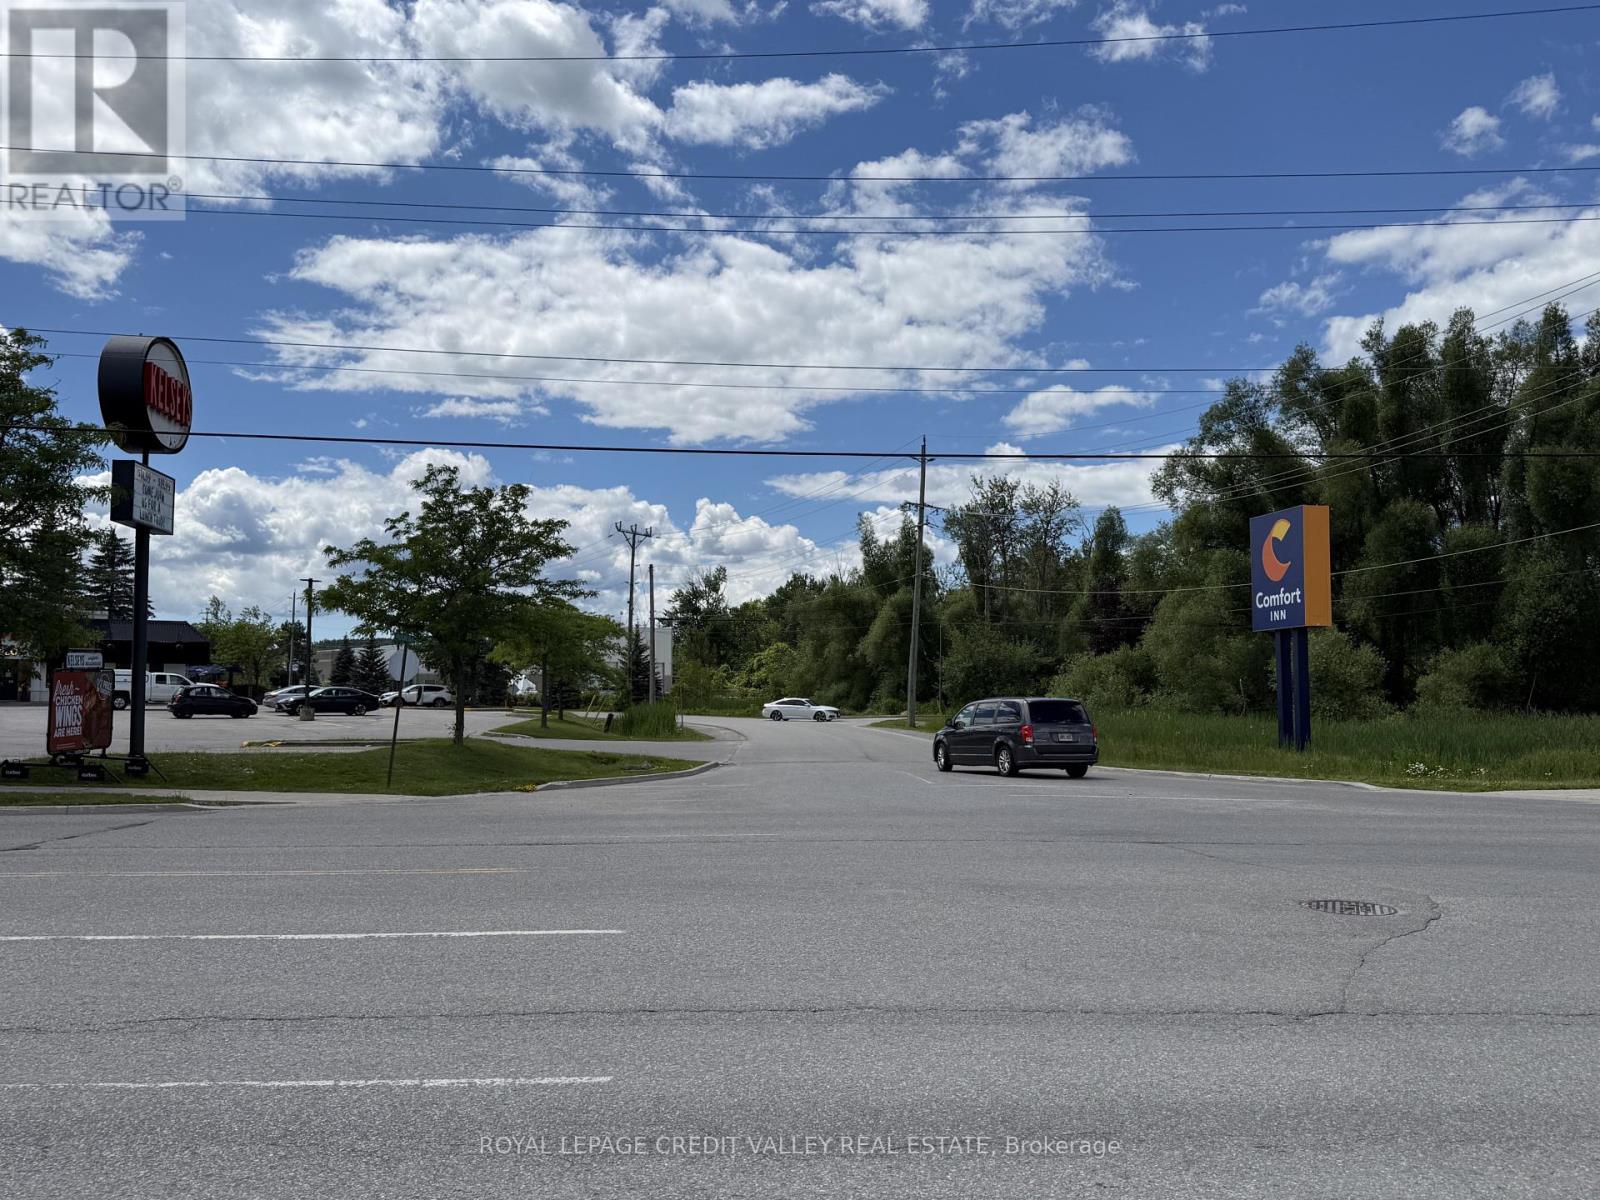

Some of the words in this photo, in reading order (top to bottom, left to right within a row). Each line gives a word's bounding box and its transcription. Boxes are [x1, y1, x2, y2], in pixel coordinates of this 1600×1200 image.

[1255, 587, 1302, 609] Comfort
[1270, 609, 1287, 622] INN
[55, 694, 83, 706] CHICKEN
[55, 704, 83, 727] WINGS
[53, 727, 65, 738] ARE
